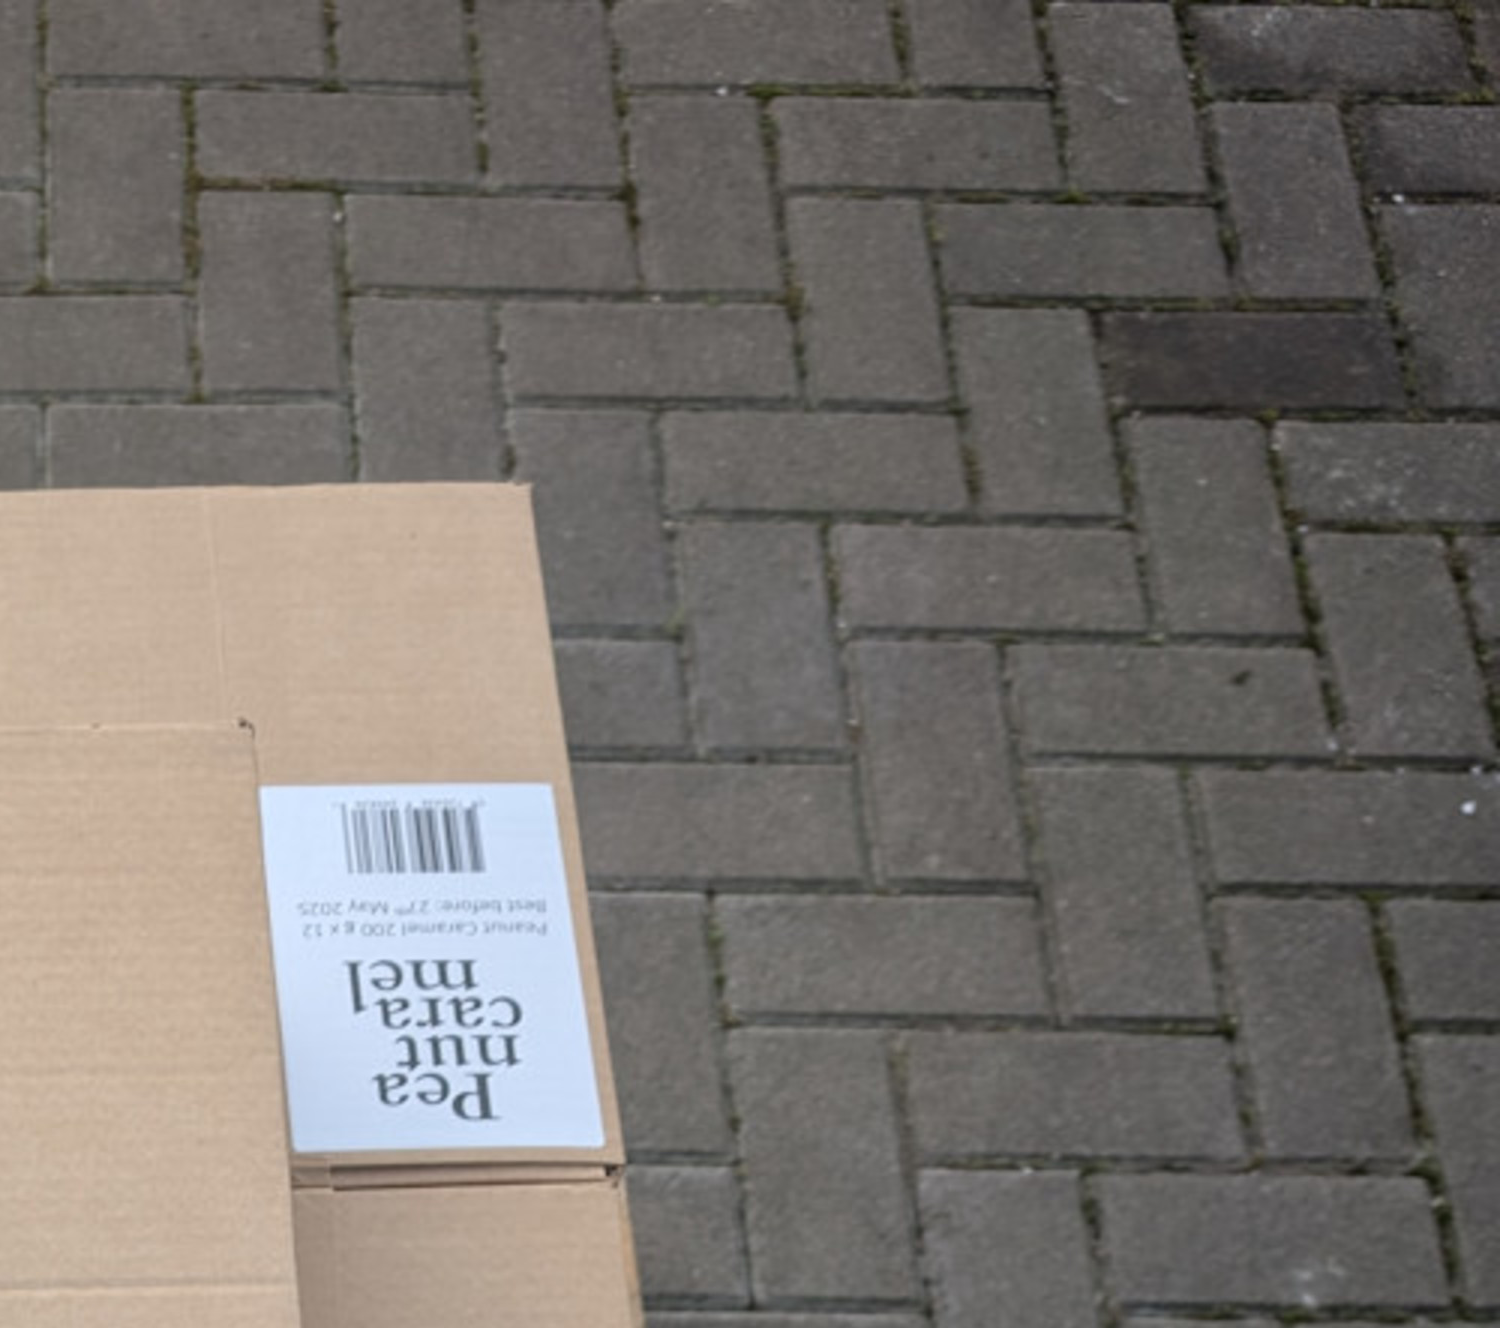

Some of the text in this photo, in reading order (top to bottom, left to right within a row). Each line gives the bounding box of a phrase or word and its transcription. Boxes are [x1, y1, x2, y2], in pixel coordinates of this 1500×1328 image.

[296, 901, 343, 917] 2025
[348, 898, 390, 916] May
[507, 899, 548, 914] Best
[302, 920, 548, 939] Peanut Caramel 200 g x 12
[346, 960, 480, 1014] mel
[375, 997, 523, 1029] cara
[396, 1035, 520, 1071] nut
[371, 1073, 499, 1120] Pea
